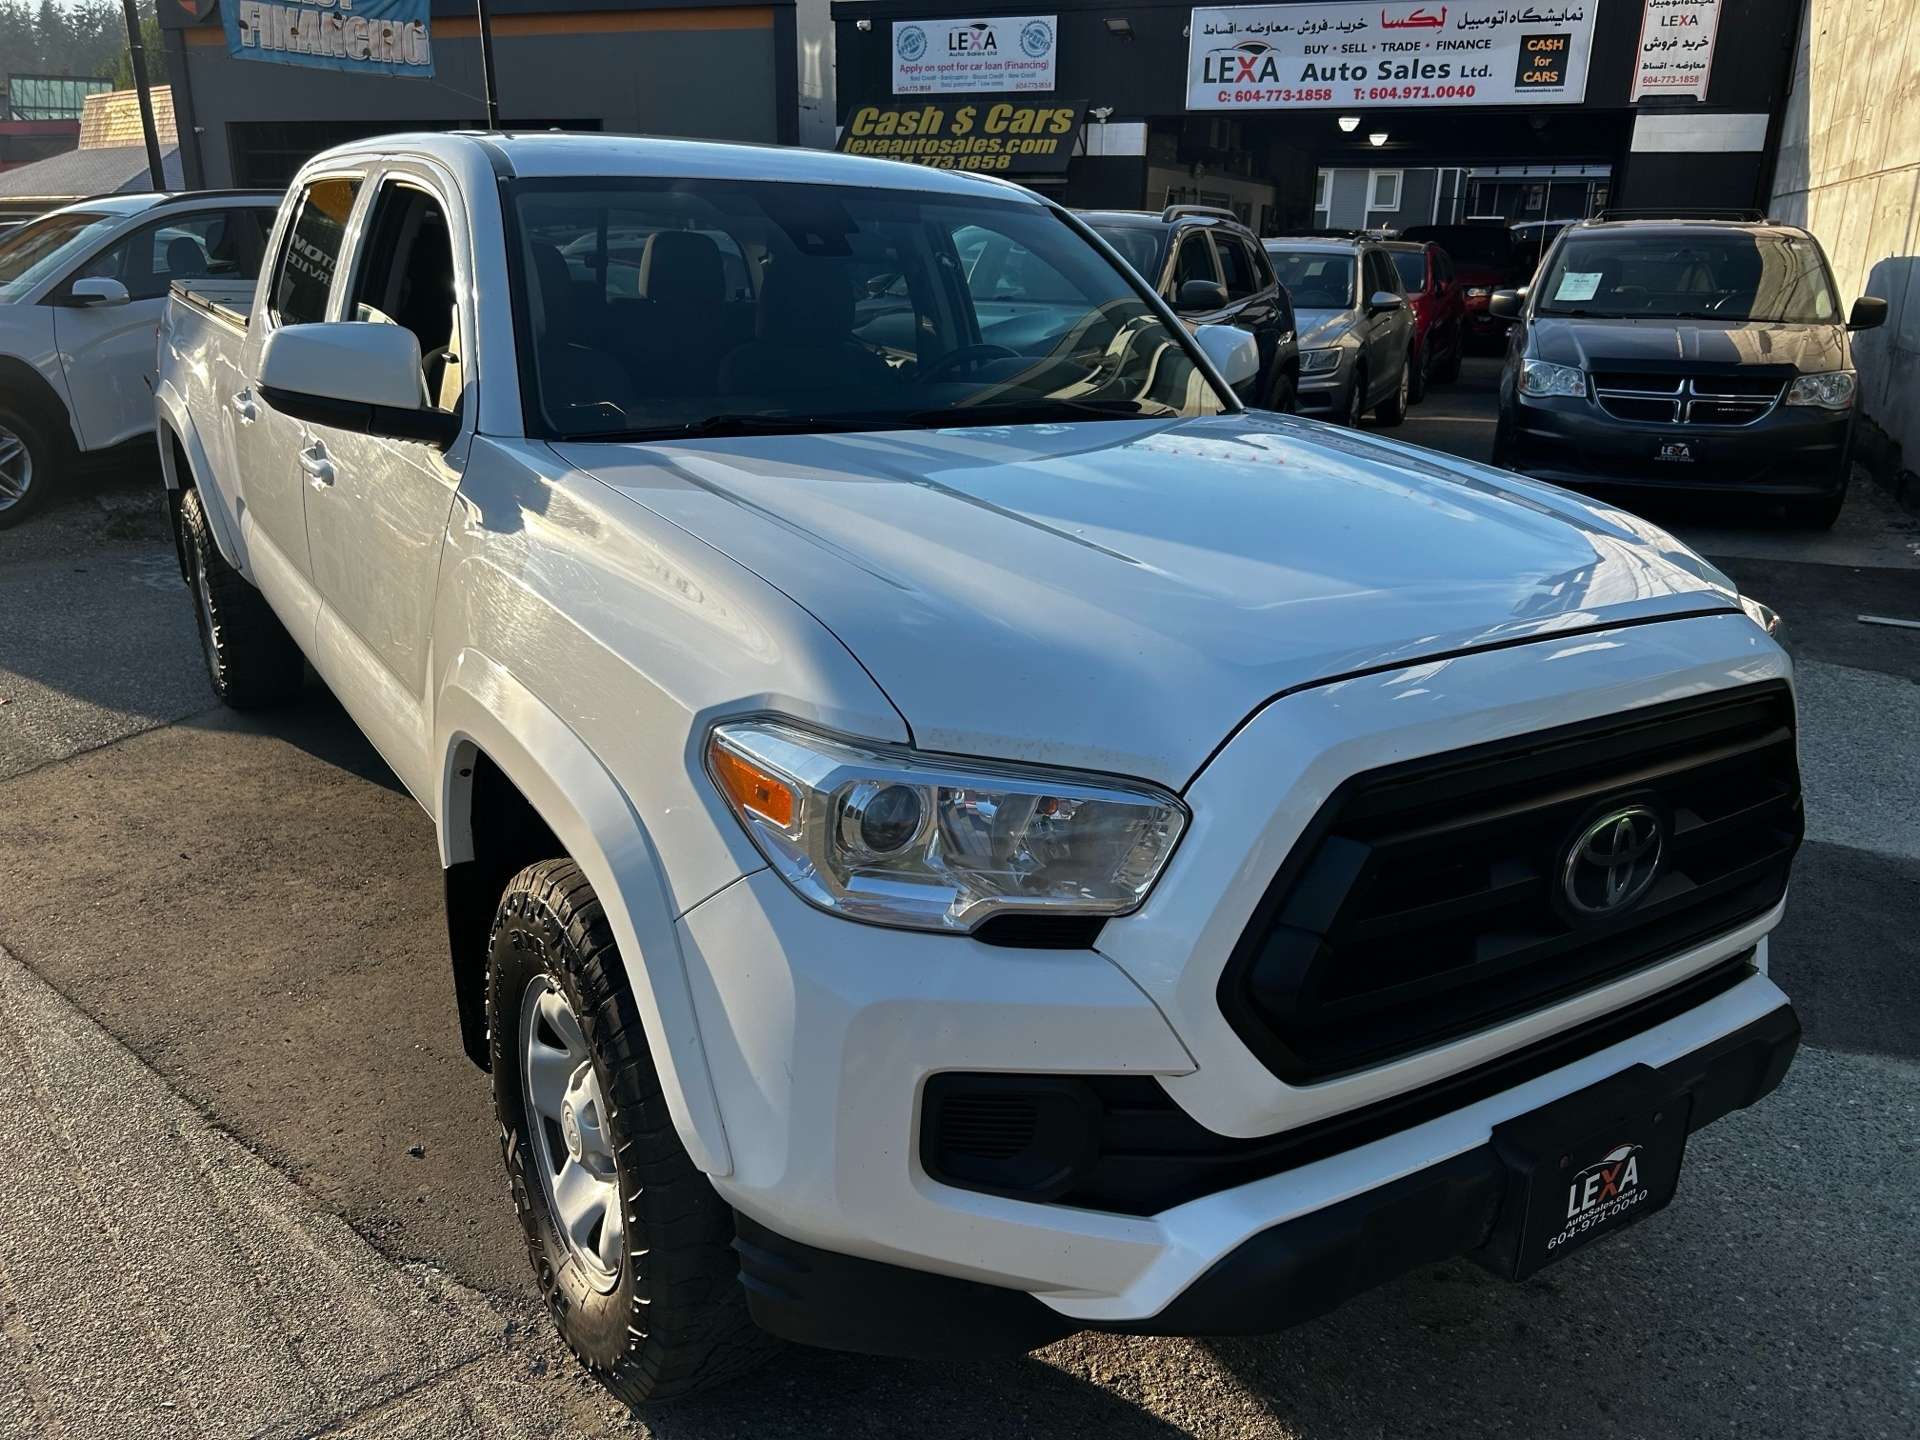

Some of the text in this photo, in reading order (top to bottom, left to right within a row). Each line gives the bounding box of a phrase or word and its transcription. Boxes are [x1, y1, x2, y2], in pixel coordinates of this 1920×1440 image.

[1661, 15, 1698, 27] LEXA
[949, 31, 998, 51] LEXA
[1304, 39, 1492, 55] BUY SELL TRADE FINANCE
[1643, 36, 1709, 52] خرید فروش
[899, 60, 1049, 74] Apply on spot for car loan (Financing)
[1534, 55, 1553, 67] for
[1203, 56, 1280, 84] LEXA
[1300, 58, 1493, 82] Auto Sales Ltd.
[1523, 71, 1559, 83] CARS
[1218, 89, 1332, 103] C: 604-773-1858
[1354, 85, 1476, 100] T: 604.971.0040
[851, 104, 1075, 136] Cash $ Cars
[843, 137, 1058, 154] lexaautosales.com
[1661, 446, 1690, 457] LEXA
[1567, 1156, 1638, 1218] LEXA
[1565, 1188, 1636, 1229] AutoSales.com
[1548, 1189, 1648, 1250] 604-971-0040
